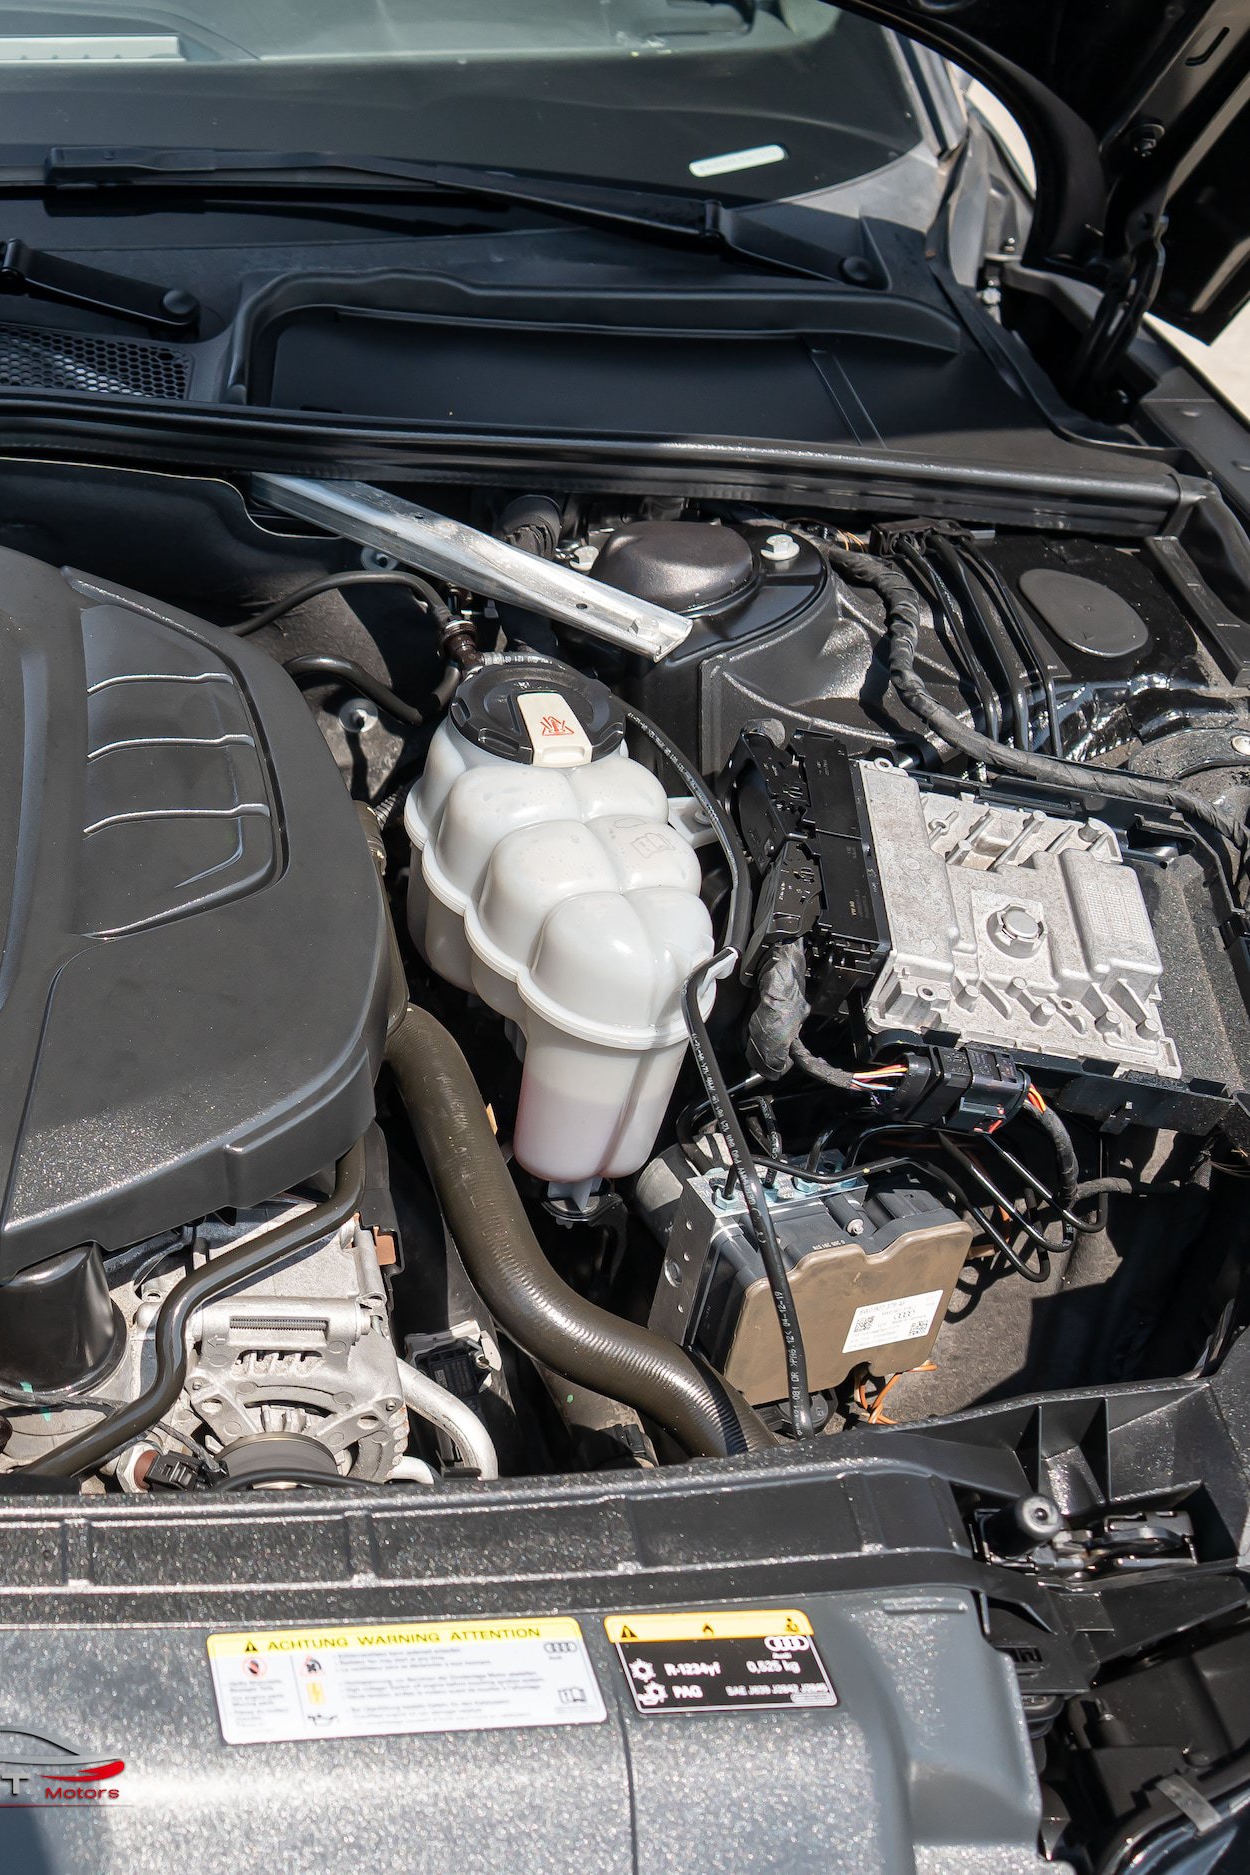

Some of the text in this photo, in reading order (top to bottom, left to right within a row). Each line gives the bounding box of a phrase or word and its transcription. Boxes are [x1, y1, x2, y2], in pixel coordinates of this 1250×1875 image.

[267, 1626, 541, 1651] ACHTUNG WARNING ATTENTION
[664, 1661, 722, 1678] R-1234yf
